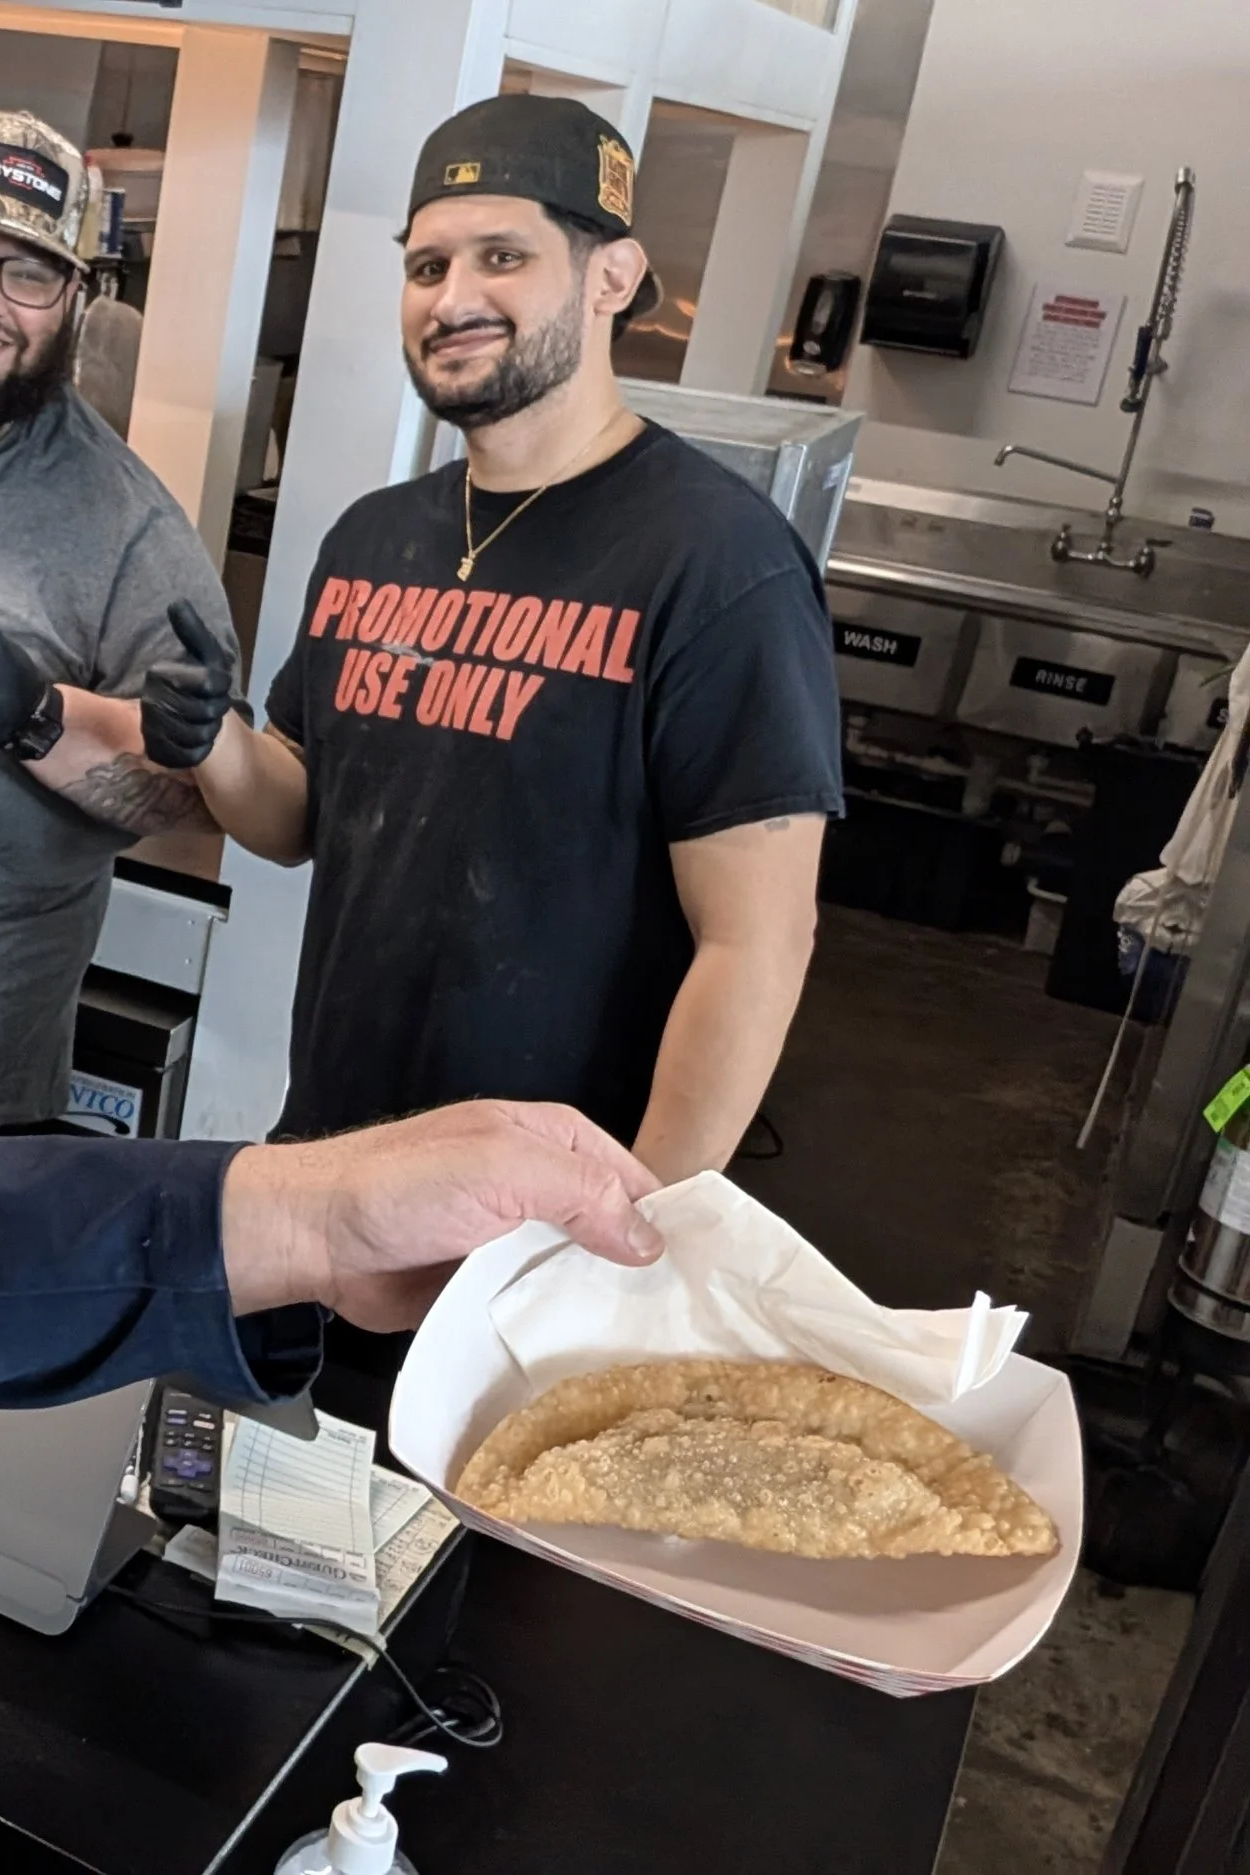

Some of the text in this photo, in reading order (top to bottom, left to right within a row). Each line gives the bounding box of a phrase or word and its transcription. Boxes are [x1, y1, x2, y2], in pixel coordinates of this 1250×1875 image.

[309, 576, 641, 684] PROMOTIONAL
[844, 630, 898, 655] WASH
[334, 648, 546, 741] USE ONLY
[1035, 668, 1088, 694] RINSE
